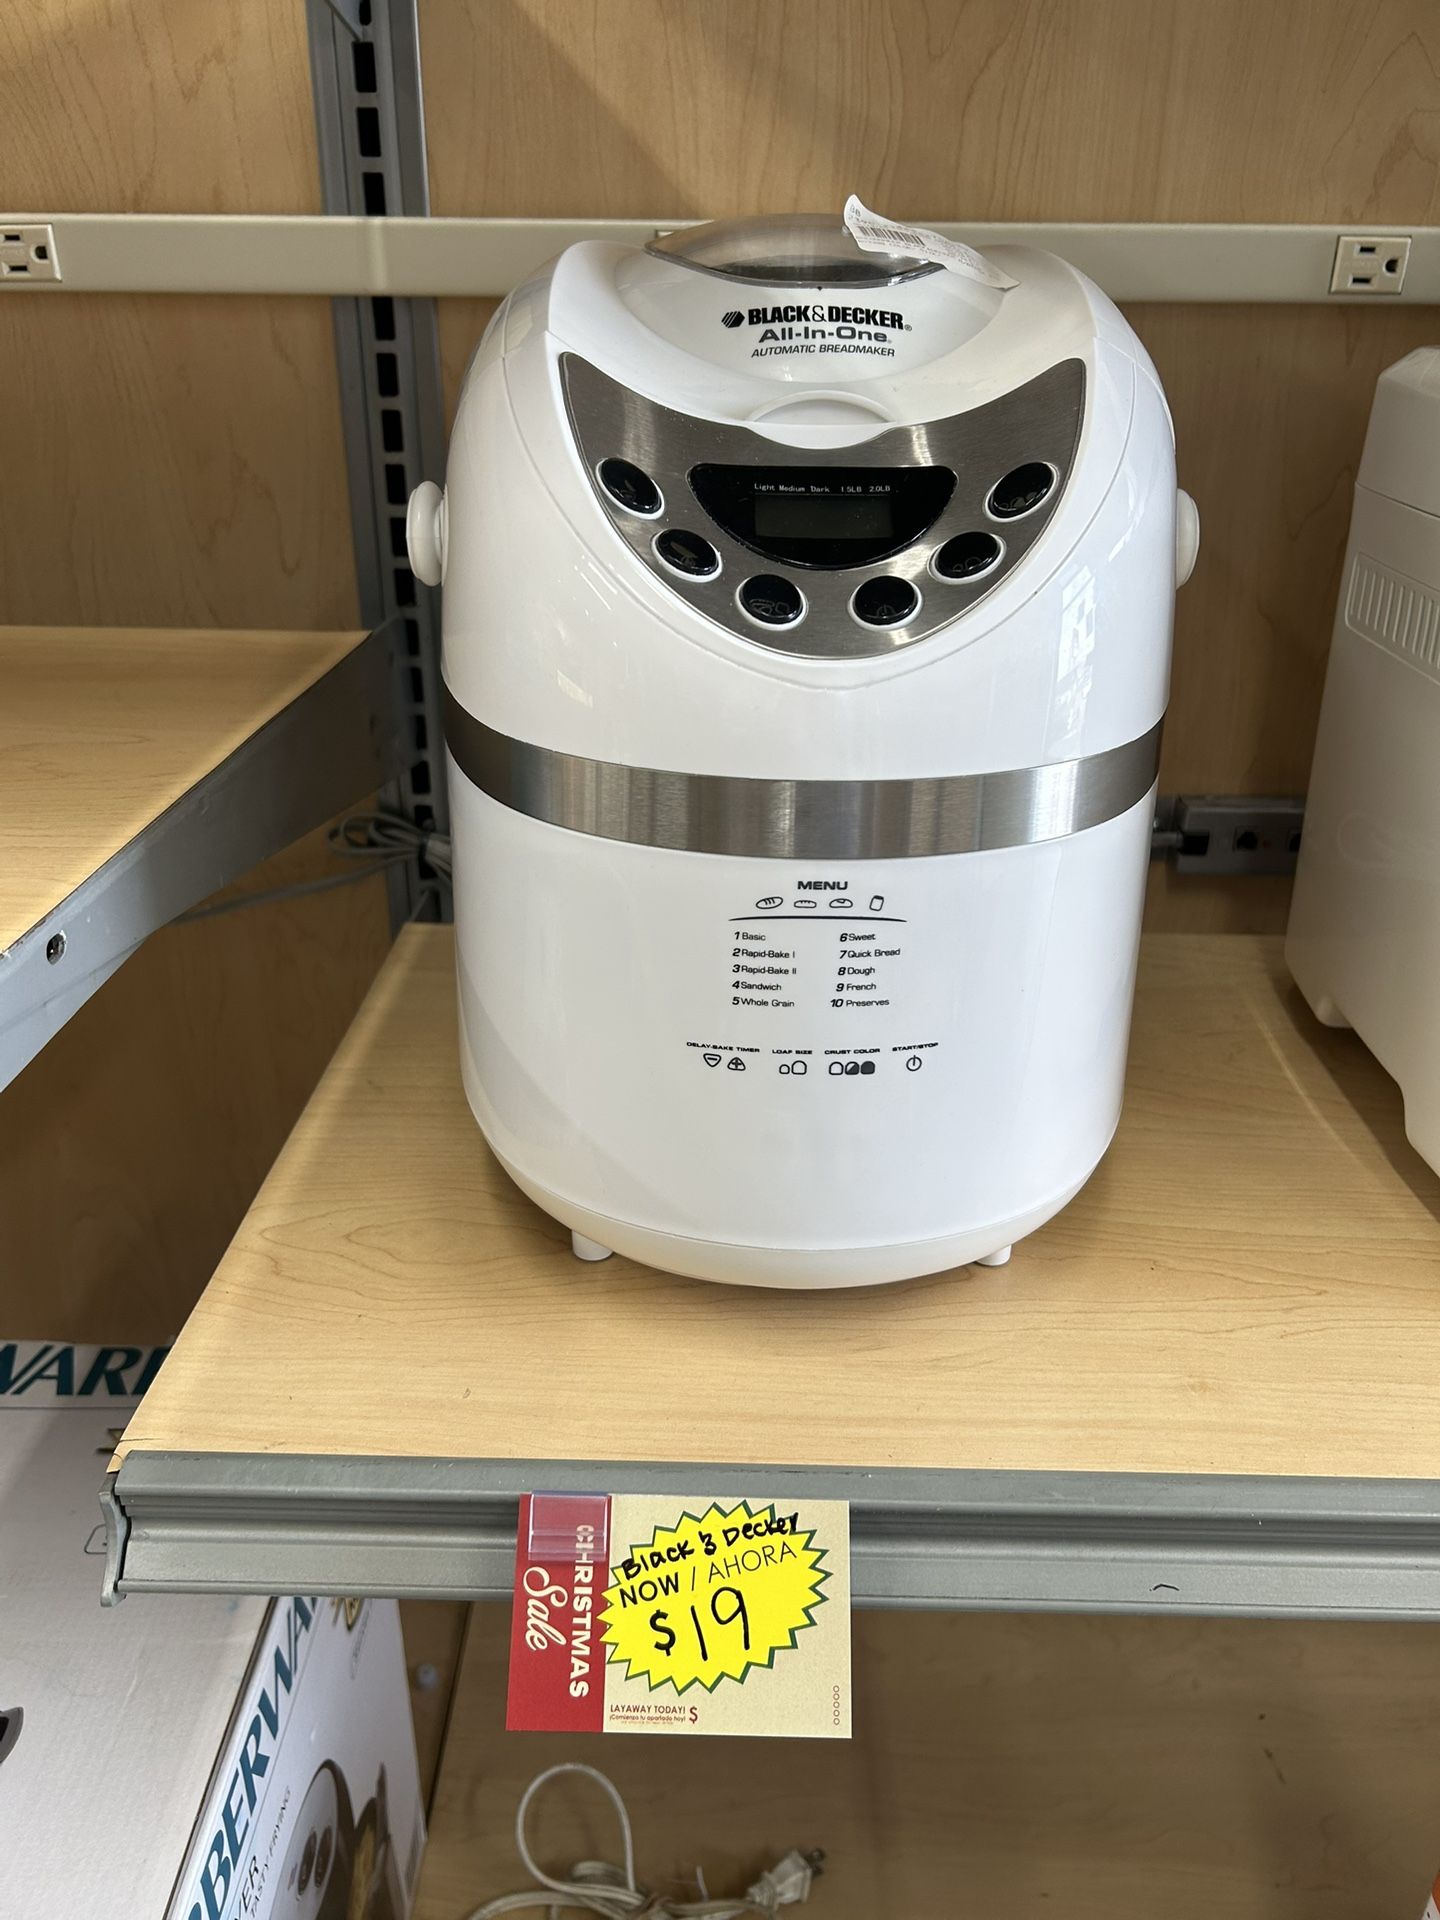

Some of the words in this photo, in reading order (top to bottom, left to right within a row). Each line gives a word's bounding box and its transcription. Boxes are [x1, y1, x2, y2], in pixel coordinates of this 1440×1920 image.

[758, 326, 888, 343] All-In-One
[751, 344, 816, 358] AUTOMATIC
[819, 344, 895, 357] BREADMAKER
[754, 483, 775, 491] Light
[810, 485, 830, 493] Dark
[797, 881, 848, 890] MENU
[734, 931, 740, 940] 1
[742, 932, 766, 941] Basic
[839, 933, 847, 942] 6
[848, 933, 876, 941] Sweet
[732, 948, 740, 957] 2
[742, 949, 789, 959] Rapid-Bake
[839, 950, 847, 959] 7
[848, 950, 871, 958] Quick
[874, 948, 900, 957] Bread
[732, 964, 740, 973] 3
[742, 965, 789, 975] Rapid-Bake
[837, 967, 846, 975] 8
[847, 966, 875, 976] Dough
[732, 981, 740, 990] 4
[741, 982, 781, 991] Sandwich
[836, 983, 844, 991] 9
[847, 983, 876, 991] French
[732, 997, 740, 1005] 5
[741, 998, 768, 1006] Whole
[772, 999, 794, 1007] Grain
[830, 998, 843, 1007] 10
[846, 998, 890, 1007] Preserves
[686, 1042, 734, 1051] DELAY-BAKE
[892, 1042, 938, 1051] START/STOP
[622, 1539, 695, 1580] Black
[722, 1512, 800, 1547] Decker
[619, 1571, 680, 1608] NOW
[708, 1541, 797, 1584] AHORA
[522, 1566, 568, 1652] Sale
[568, 1524, 595, 1698] CHRISTMAS
[610, 1704, 652, 1713] LAYAWAY
[654, 1705, 685, 1714] TODAY!
[689, 1706, 698, 1724] $
